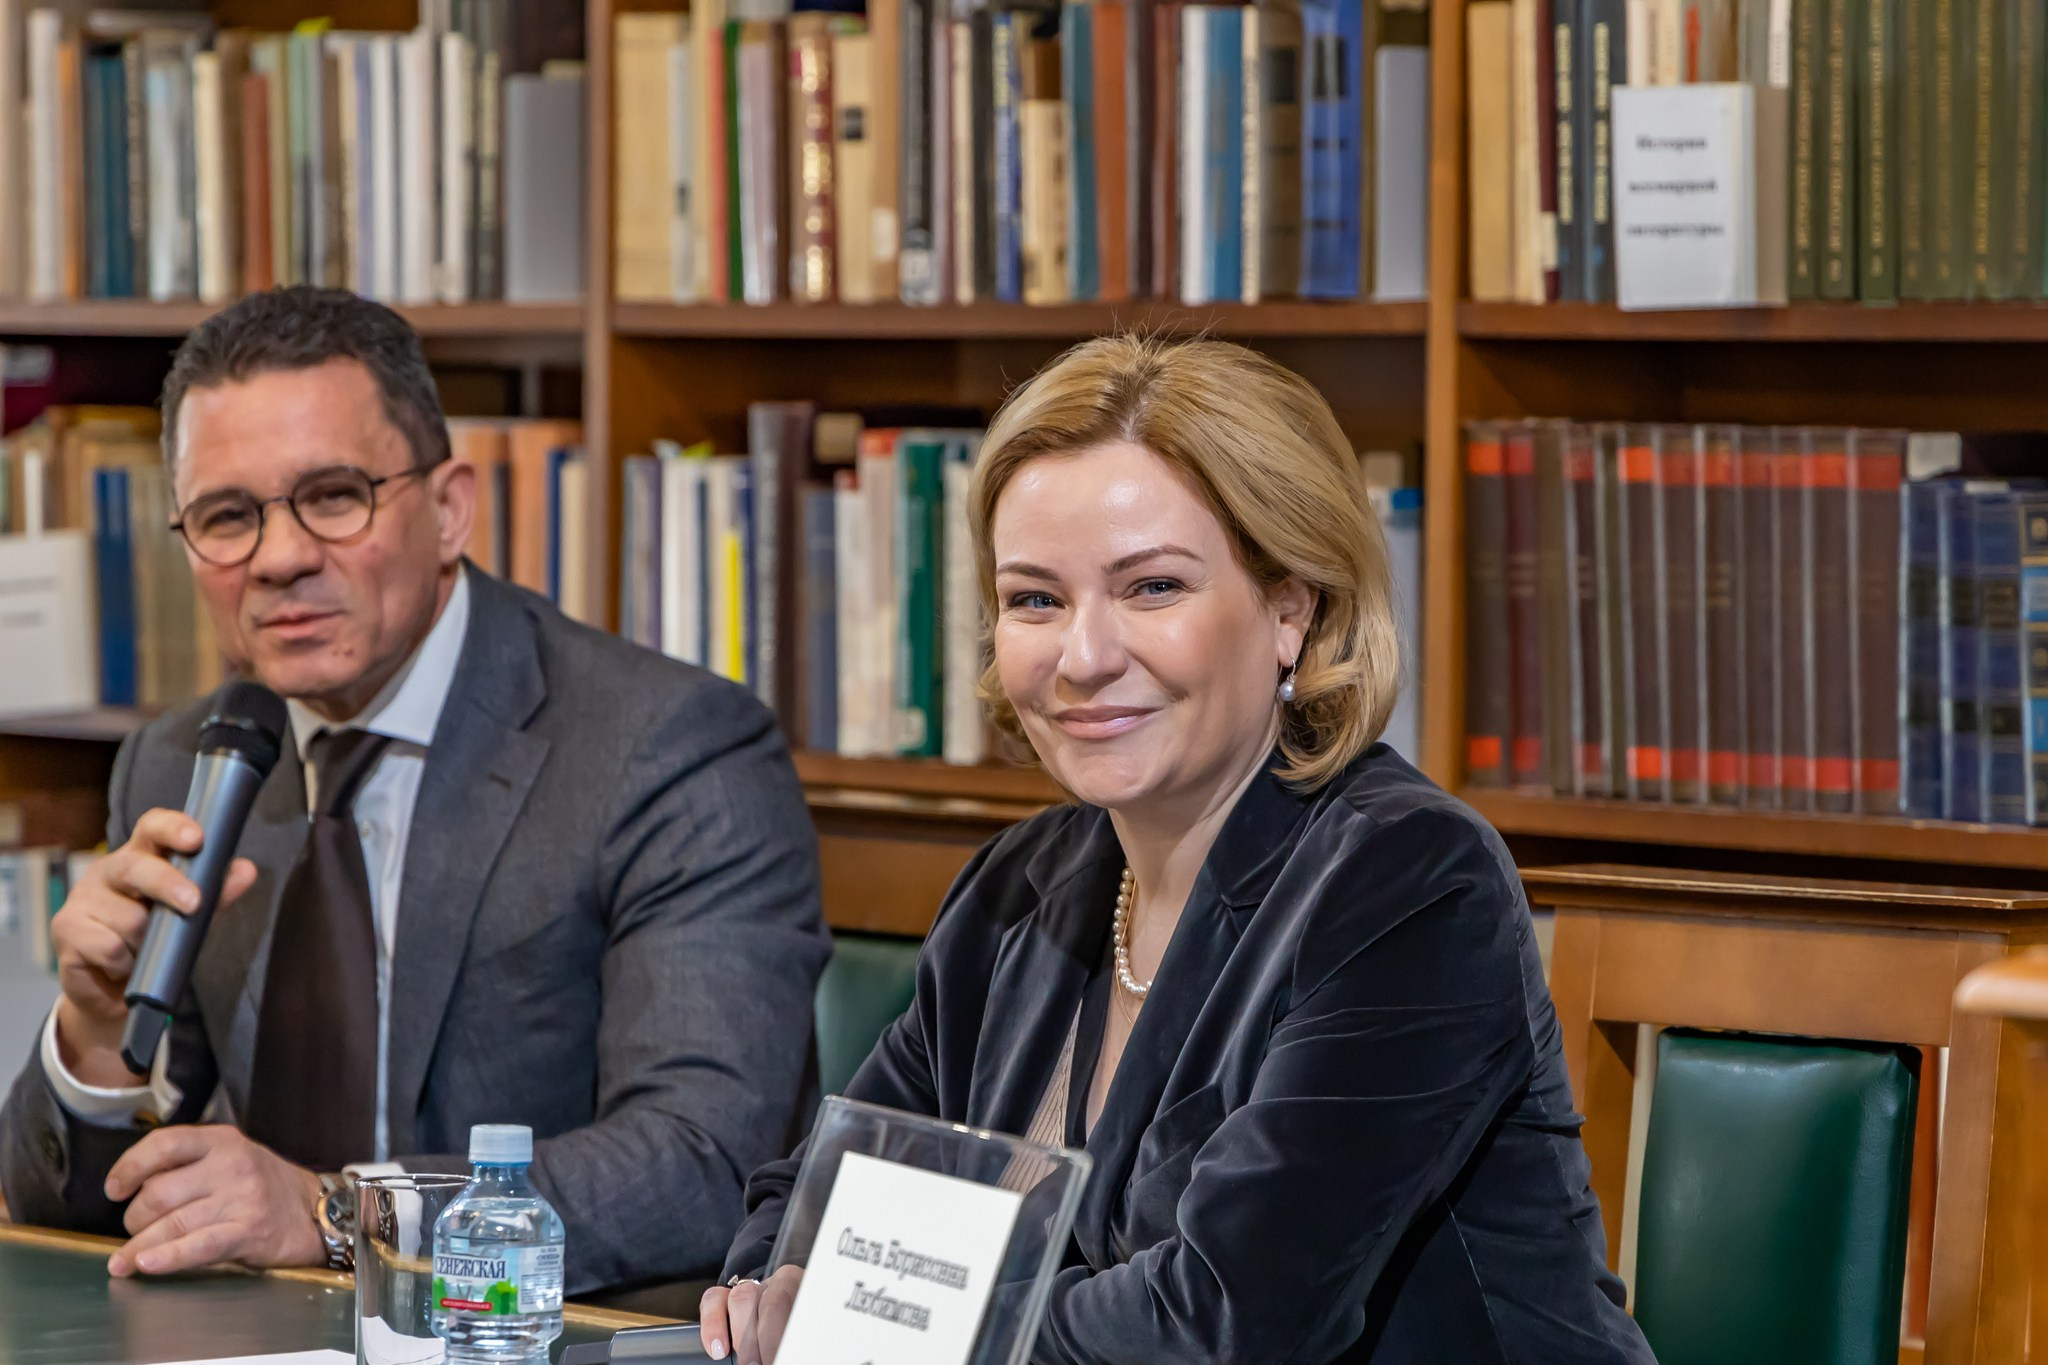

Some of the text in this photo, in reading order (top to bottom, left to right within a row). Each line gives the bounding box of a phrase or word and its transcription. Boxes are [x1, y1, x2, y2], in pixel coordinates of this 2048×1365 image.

[837, 1227, 969, 1290] Ольга Борисовна
[844, 1281, 931, 1331] Любимова
